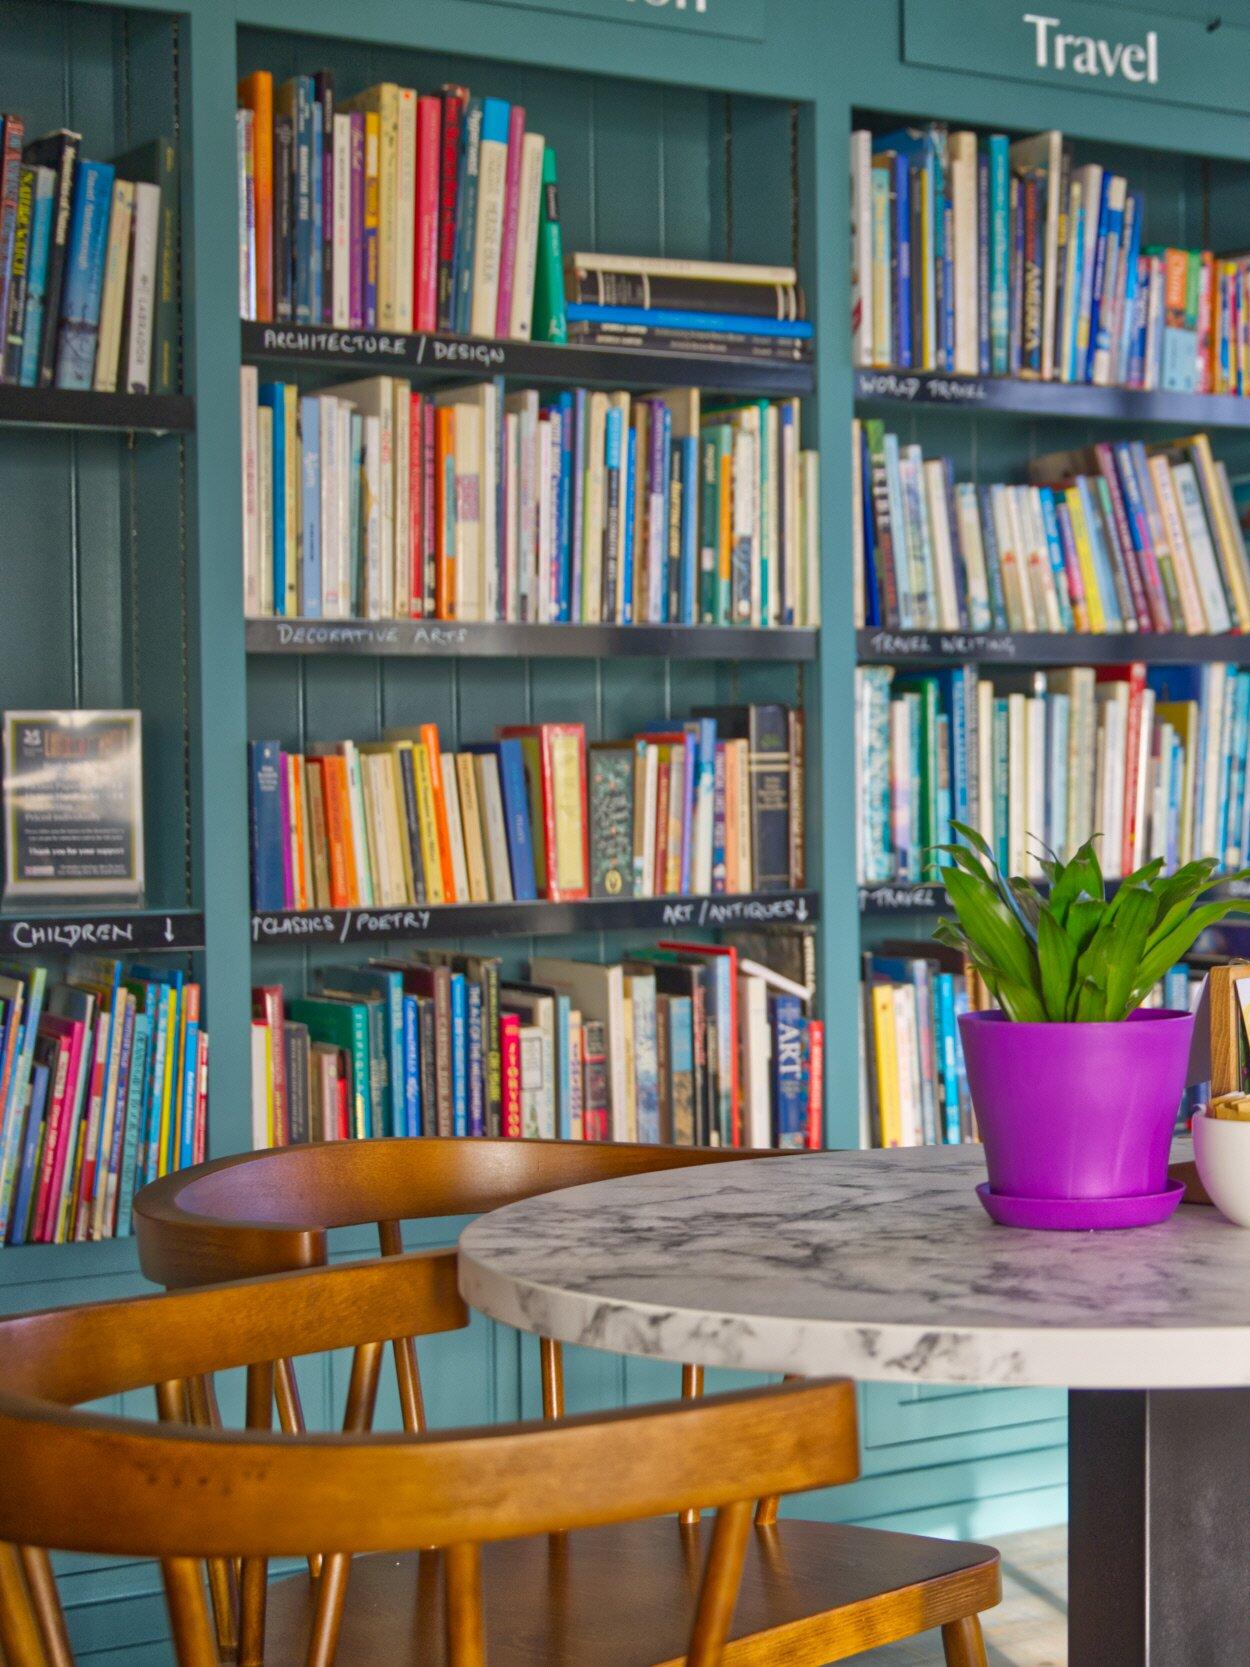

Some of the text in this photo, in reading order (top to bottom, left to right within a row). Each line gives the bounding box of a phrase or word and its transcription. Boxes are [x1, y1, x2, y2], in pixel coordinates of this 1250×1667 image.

[1022, 13, 1158, 84] Travel
[264, 328, 406, 355] ARCHITECTURE
[432, 341, 505, 367] DESIGN
[859, 374, 988, 401] WORLD TRAVEL
[277, 623, 468, 646] DECORATIVE ARTS
[871, 632, 1017, 658] TRAVEL WRITING
[869, 886, 936, 908] TRAVEL
[262, 914, 335, 934] CLASSICS
[356, 910, 431, 931] POETRY
[663, 903, 695, 925] ART
[709, 899, 796, 924] ANTIQUES
[12, 921, 133, 949] CHILDREN
[778, 1021, 801, 1081] ART
